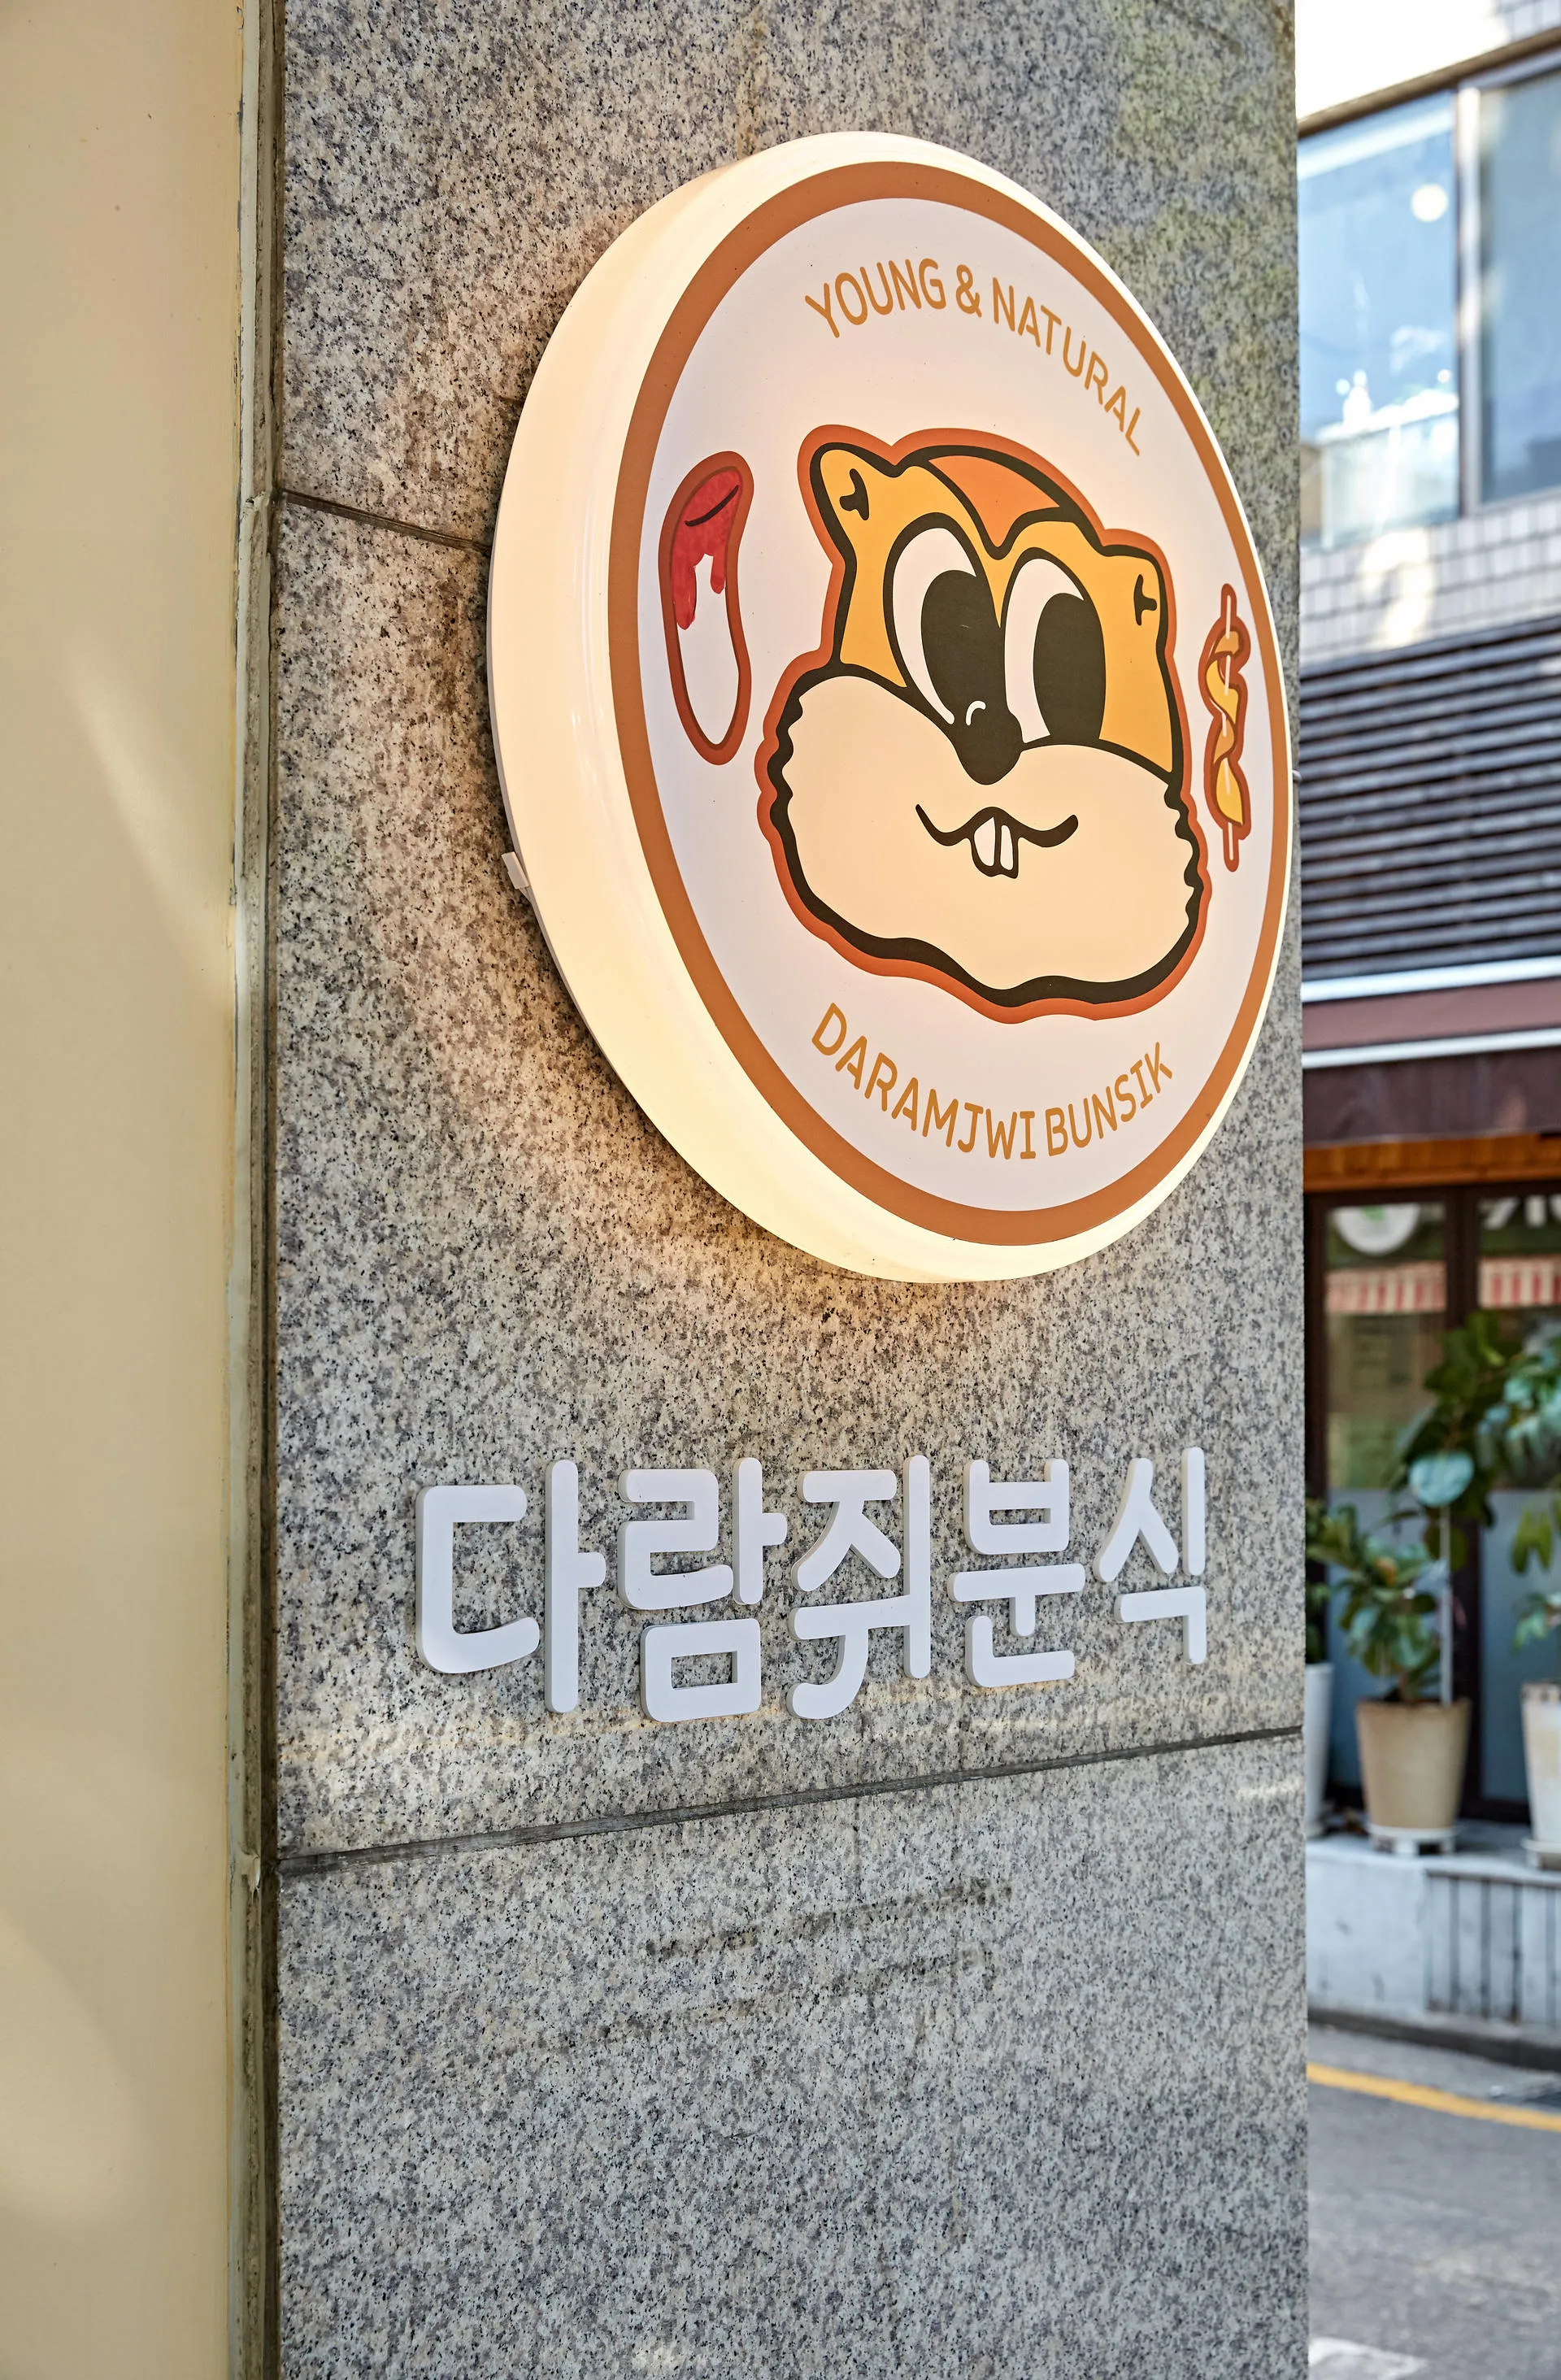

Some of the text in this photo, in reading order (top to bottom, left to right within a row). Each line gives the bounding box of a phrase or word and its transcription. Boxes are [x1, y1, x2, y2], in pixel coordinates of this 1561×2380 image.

[805, 258, 1140, 456] YOUNG & NATURAL
[811, 1003, 1172, 1160] DARAMJWI BUNSIK
[415, 1447, 1207, 1722] 다람쥐분식
